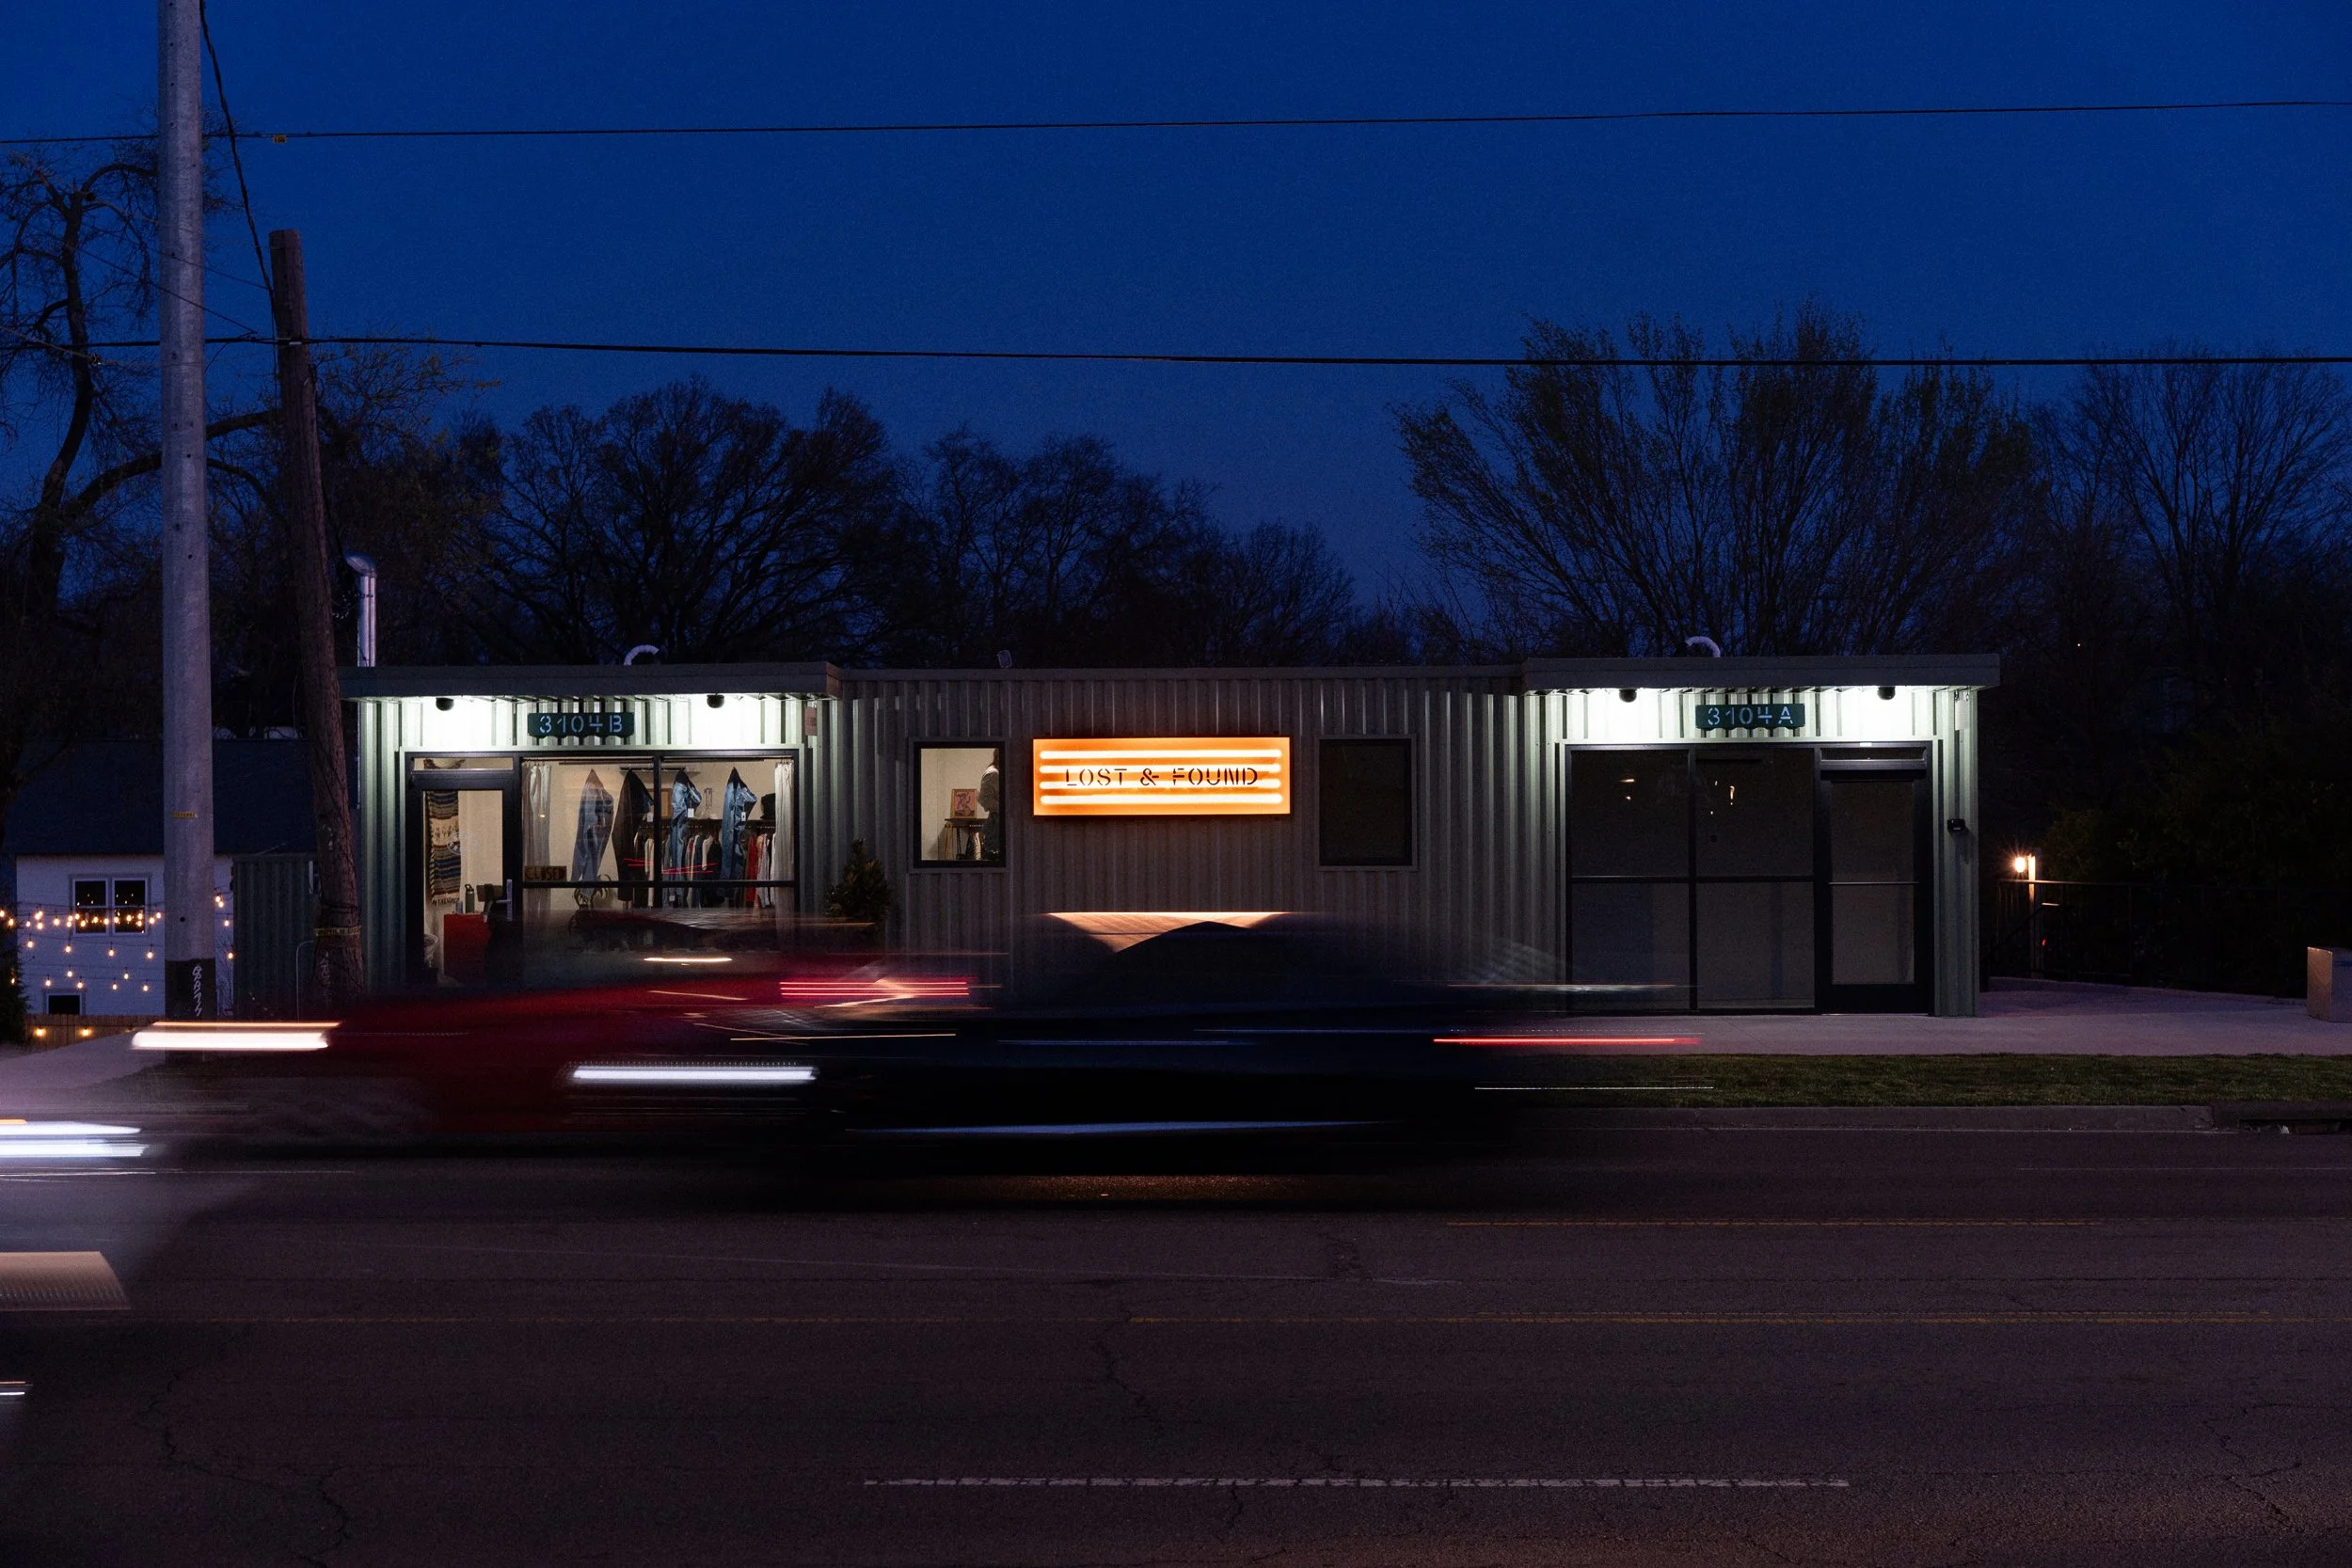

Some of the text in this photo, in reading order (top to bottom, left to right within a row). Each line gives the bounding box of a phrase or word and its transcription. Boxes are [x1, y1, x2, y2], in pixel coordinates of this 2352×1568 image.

[539, 715, 623, 734] 3104B
[1707, 706, 1794, 725] 3104A
[1065, 768, 1259, 786] LOST & FOUND
